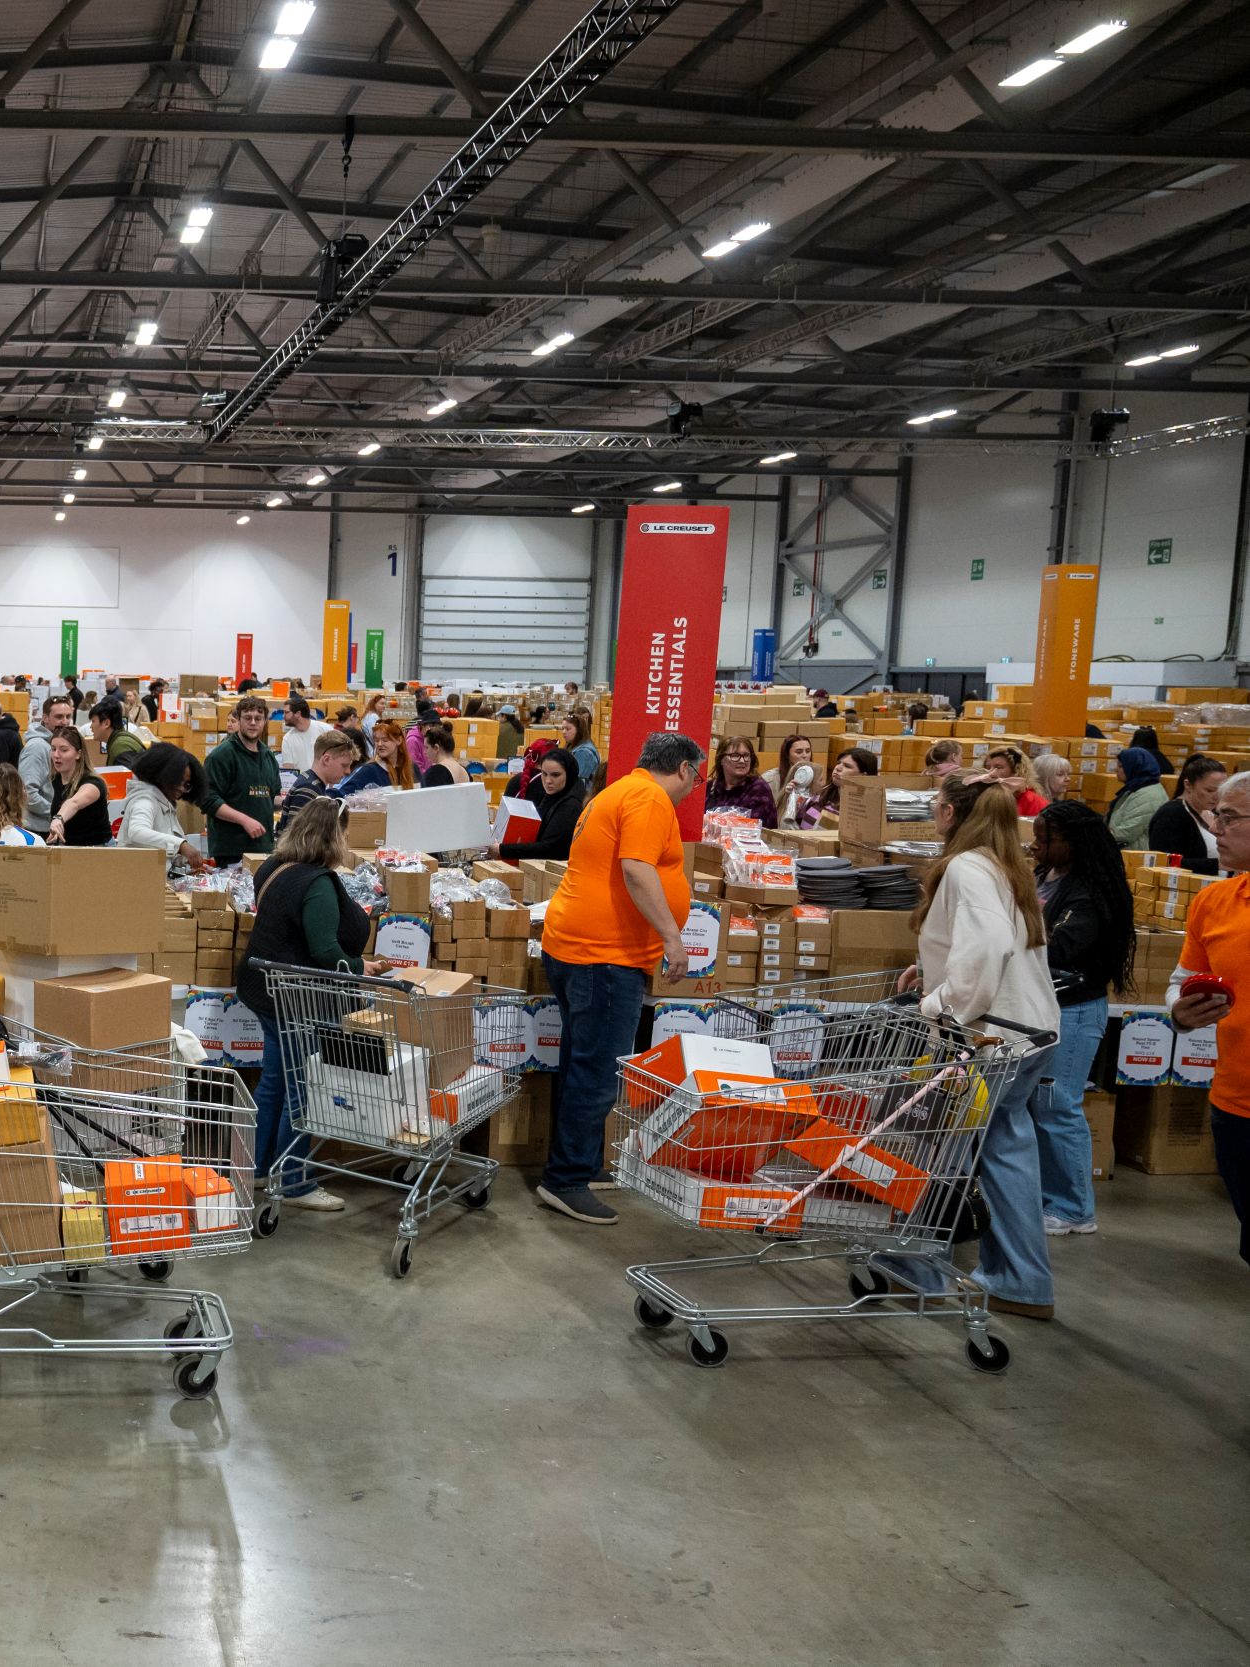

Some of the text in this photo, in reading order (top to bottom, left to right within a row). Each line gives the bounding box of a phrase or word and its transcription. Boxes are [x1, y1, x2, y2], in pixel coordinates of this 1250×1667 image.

[388, 552, 397, 576] 1
[646, 632, 666, 714] KITCHEN
[665, 617, 688, 731] ESSENTIALS
[1070, 617, 1081, 680] STONEWARE
[694, 982, 721, 994] A13
